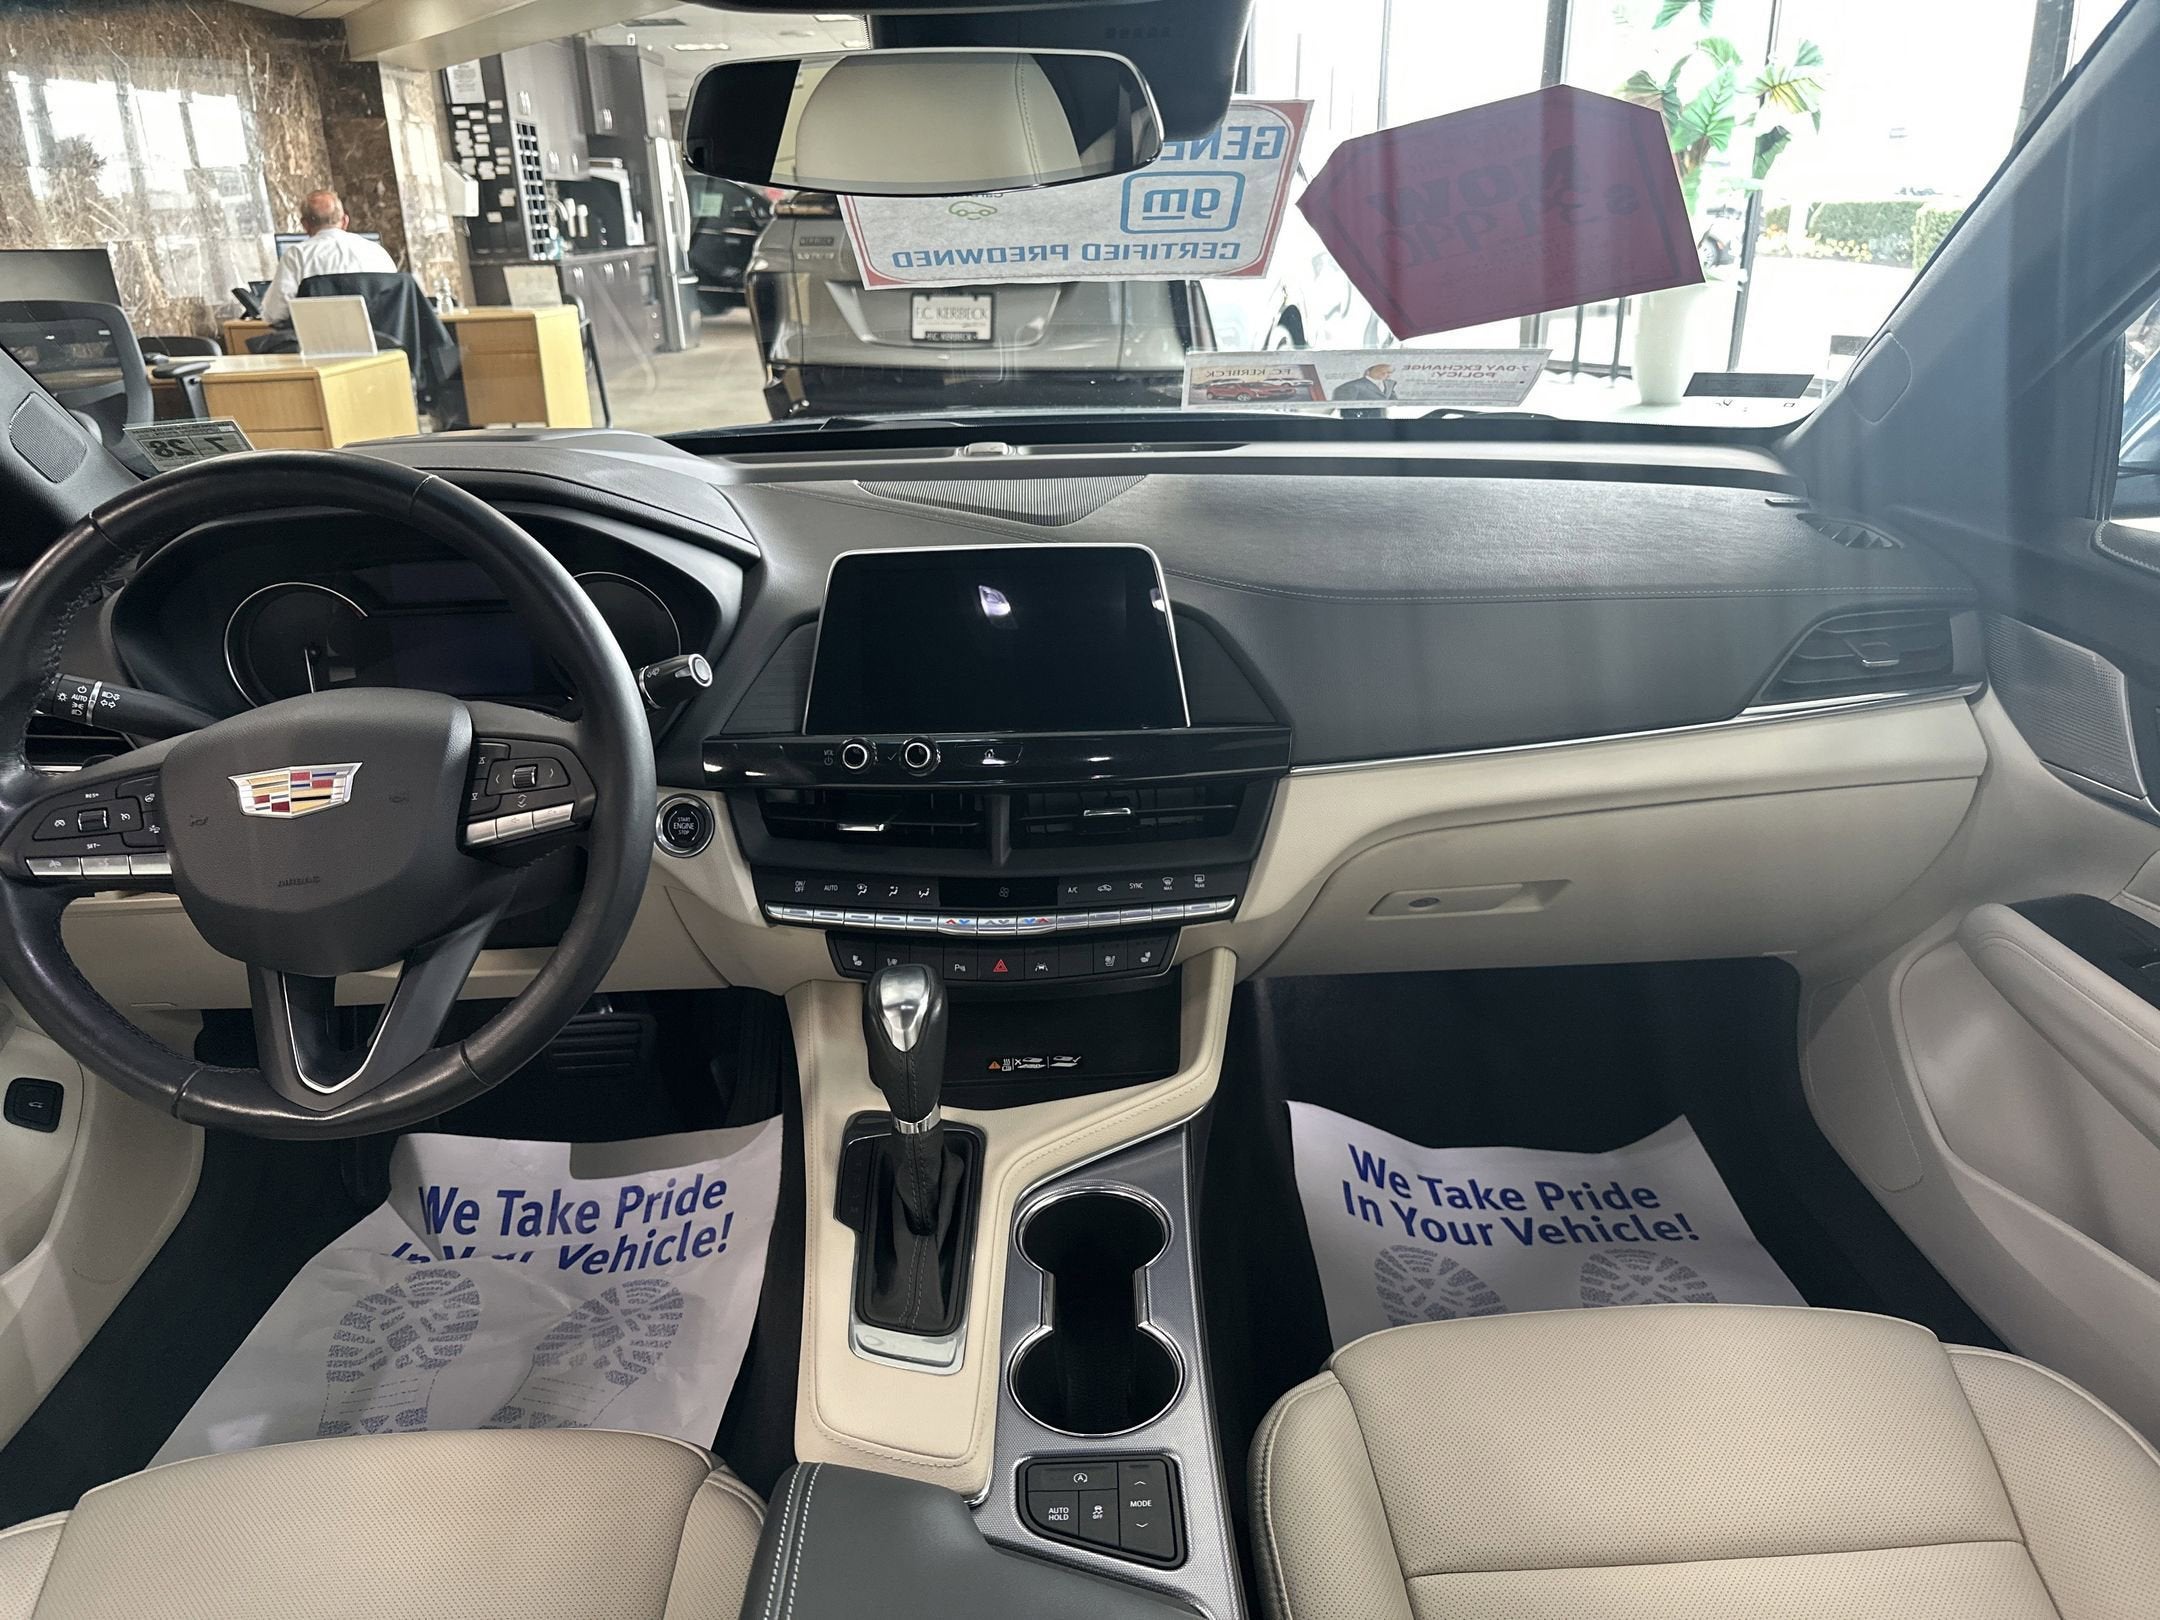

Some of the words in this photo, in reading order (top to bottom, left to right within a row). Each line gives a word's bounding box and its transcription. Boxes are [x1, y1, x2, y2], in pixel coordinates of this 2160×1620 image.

[71, 694, 88, 702] AUTO
[1067, 886, 1078, 894] A/C
[418, 1186, 480, 1236] We
[497, 1188, 600, 1237] Take
[614, 1173, 727, 1230] Pride
[1348, 1143, 1412, 1199] We
[1416, 1174, 1527, 1212] Take
[1534, 1181, 1661, 1211] Pride
[558, 1211, 734, 1275] Vehicle!
[1342, 1180, 1384, 1227] In
[1389, 1199, 1493, 1246] Your
[1500, 1213, 1700, 1246] Vehicle!
